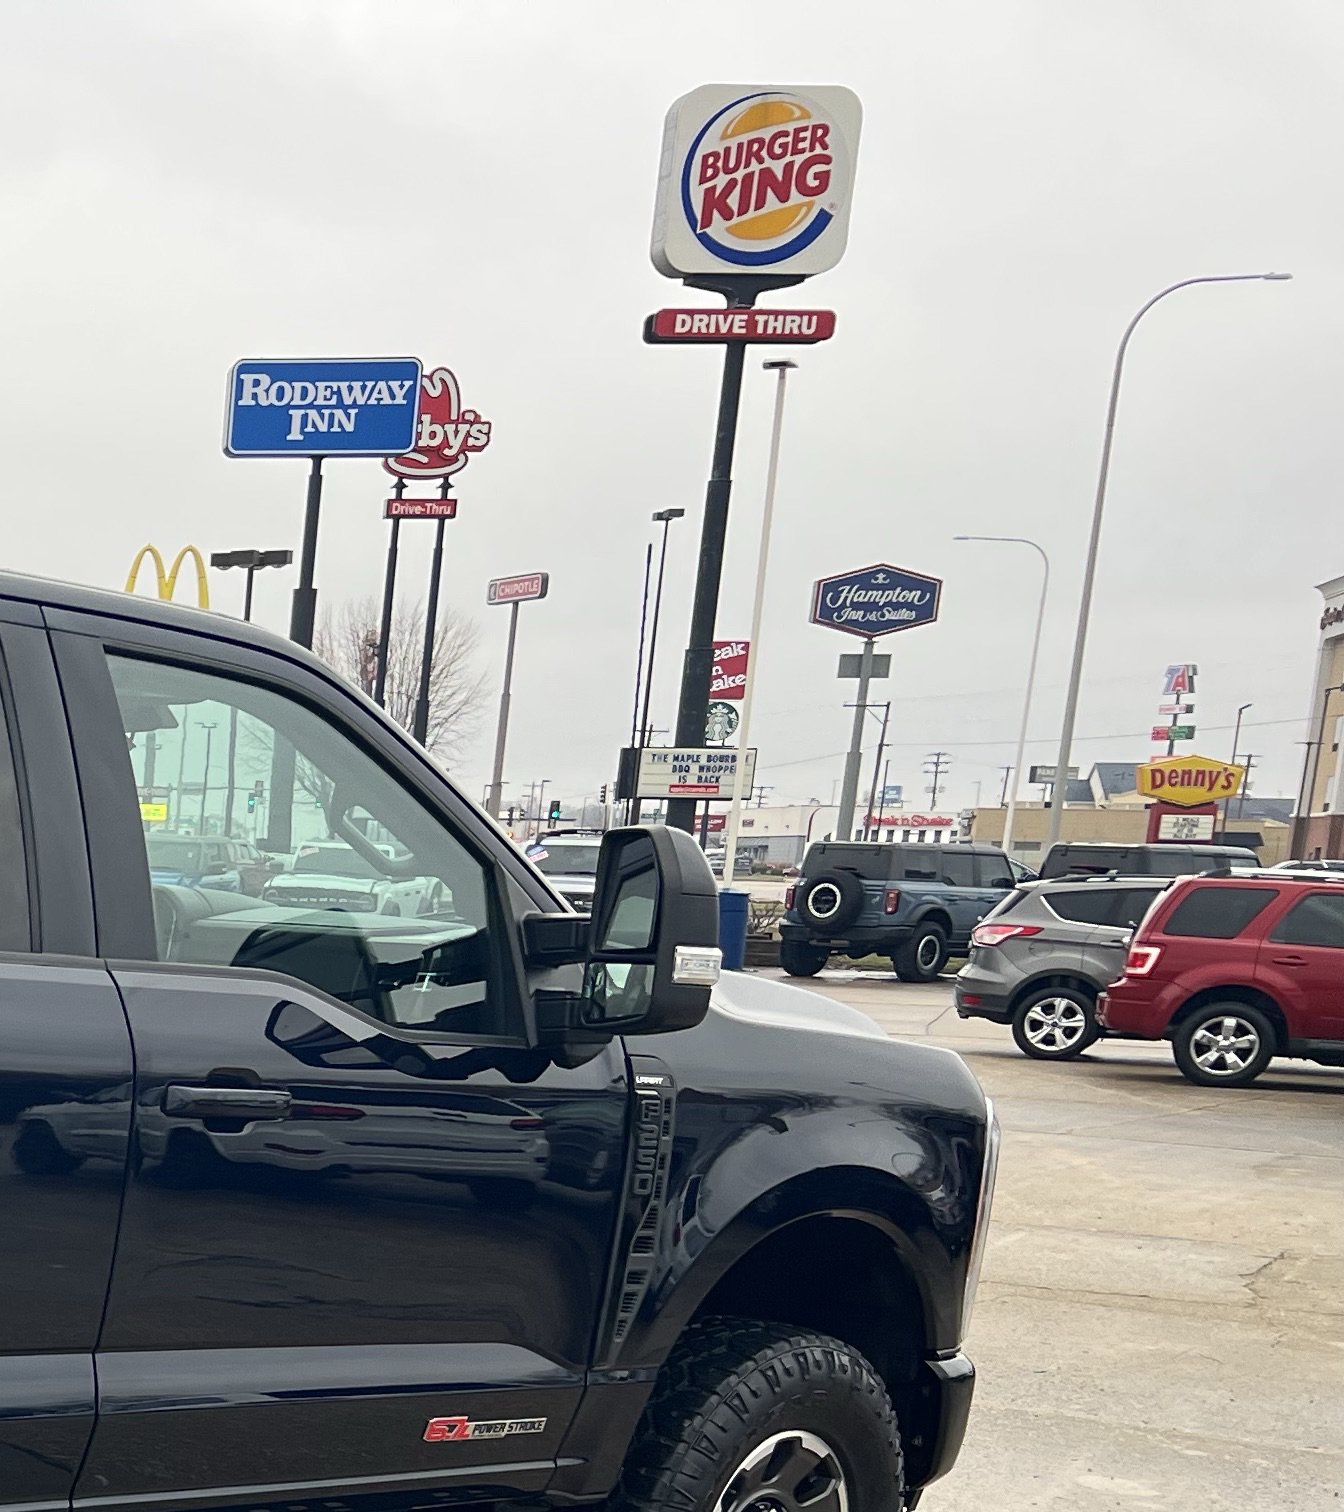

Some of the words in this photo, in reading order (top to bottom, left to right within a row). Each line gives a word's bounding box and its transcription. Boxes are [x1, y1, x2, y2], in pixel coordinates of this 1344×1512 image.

[698, 123, 831, 186] BURGER
[697, 153, 833, 232] KING
[674, 313, 749, 335] DRIVE
[754, 314, 819, 335] THRU
[237, 373, 414, 407] RODEWAY
[285, 408, 359, 441] INN
[417, 411, 491, 456] by's
[391, 501, 452, 516] Drive-Thru
[499, 579, 539, 597] CHIPOTLE
[826, 583, 930, 608] Hampton
[833, 607, 868, 622] Inn
[877, 606, 916, 621] Suites
[712, 642, 746, 661] eak
[710, 673, 746, 692] ake
[652, 753, 669, 764] THE
[672, 753, 701, 764] MAPLE
[706, 753, 749, 764] BOURB
[678, 775, 688, 784] IS
[696, 774, 721, 784] BACK
[1150, 766, 1236, 792] Denny's
[472, 1422, 506, 1434] POWER
[507, 1420, 544, 1433] STROKE
